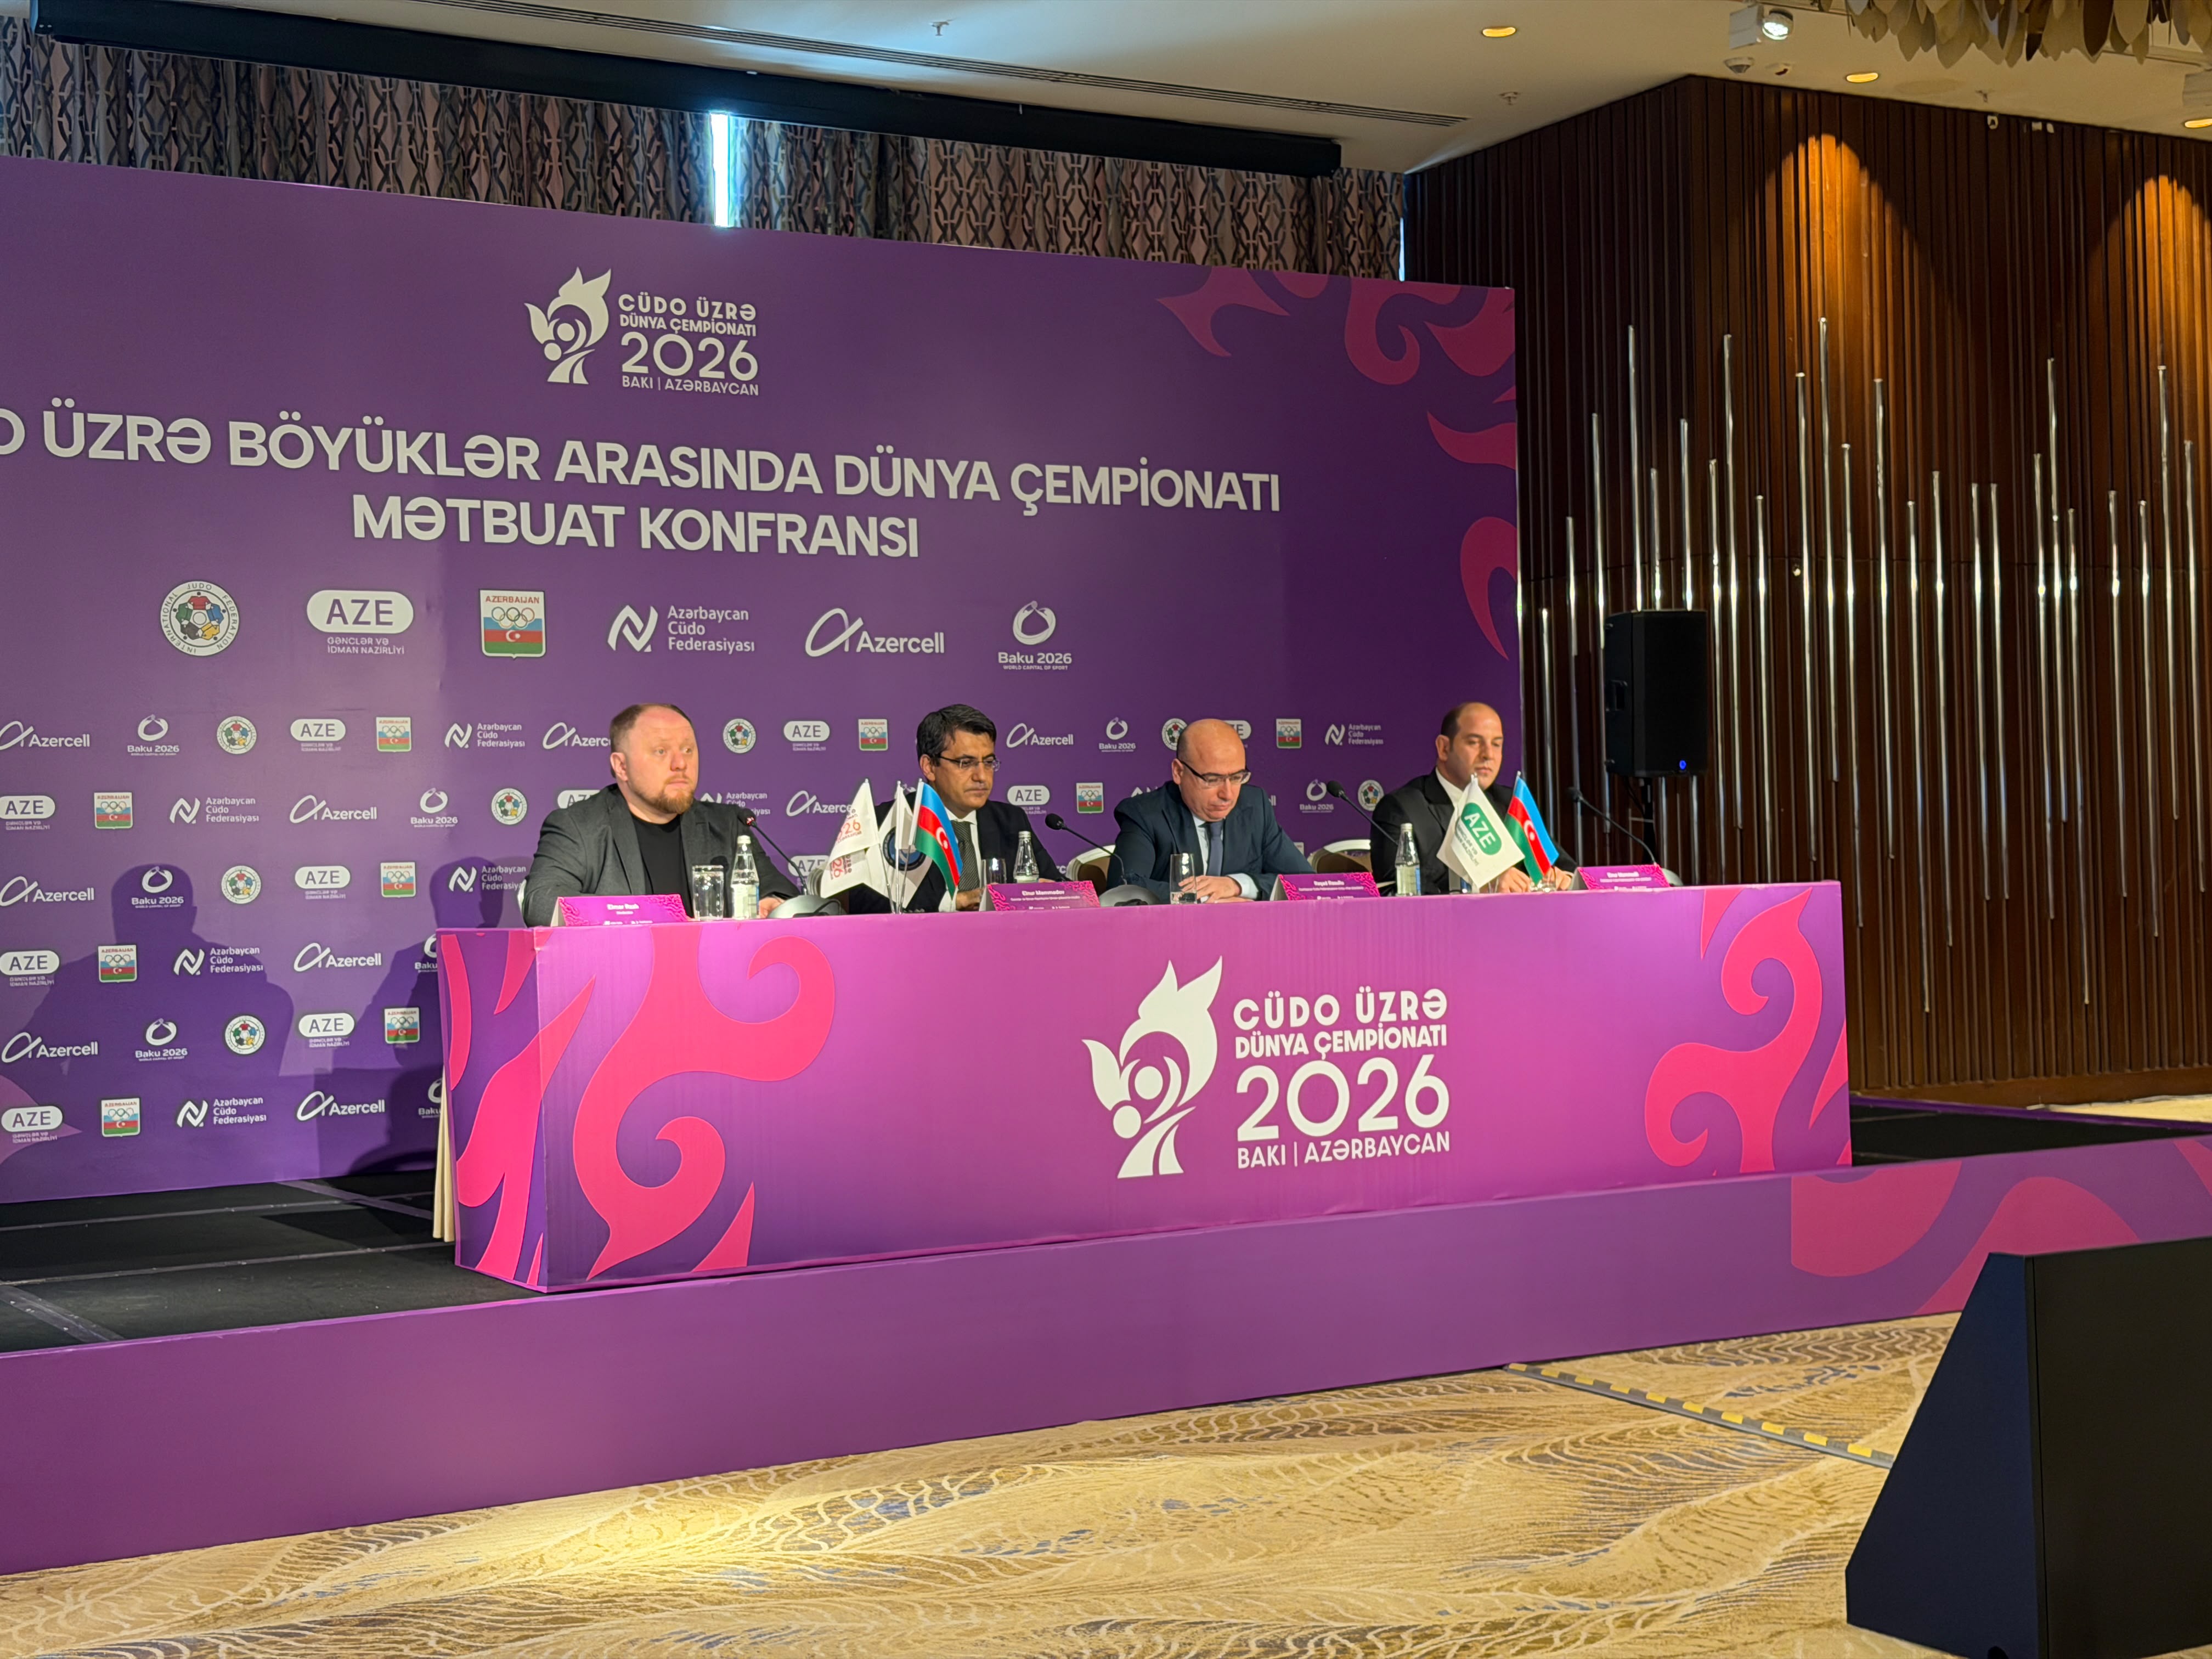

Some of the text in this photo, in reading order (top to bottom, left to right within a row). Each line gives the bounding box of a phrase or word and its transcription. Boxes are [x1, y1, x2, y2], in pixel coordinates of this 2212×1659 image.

[618, 291, 756, 321] CÜDO ÜZRƏ
[620, 313, 757, 336] DÜNYA ÇEMPİONATI
[621, 331, 758, 381] 2026
[622, 376, 759, 396] BAKI AZƏRBAYCAN
[43, 397, 211, 464] ÜZRƏ
[229, 411, 541, 481] BÖYÜKLƏR
[554, 441, 822, 494] ARASINDA
[836, 445, 1000, 501] DÜNYA
[1011, 457, 1280, 516] ÇEMPİONATI
[353, 494, 918, 557] MƏTBUAT KONFRANSI
[486, 595, 539, 604] AZERBAIJAN
[326, 599, 393, 625] AZE
[668, 606, 749, 621] Azərbaycan
[162, 592, 196, 654] INTERNATIONAL
[216, 595, 238, 651] FEDERATION
[668, 622, 706, 635] Cüdo
[668, 637, 754, 654] Federasiyası
[856, 631, 945, 653] Azercell
[998, 652, 1072, 664] Baku 2026
[301, 724, 335, 737] AZE
[477, 723, 522, 732] Azərbaycan
[792, 725, 821, 737] AZE
[30, 733, 90, 748] Azercell
[477, 739, 525, 748] Federasiyası
[572, 734, 611, 746] Azerc
[1031, 734, 1073, 746] Azercell
[127, 745, 179, 753] Baku 2026
[206, 797, 256, 806] Azərbaycan
[726, 792, 768, 801] Azərbaycan
[1015, 789, 1042, 802] AZE
[5, 800, 43, 815] AZE
[812, 802, 853, 813] Azerce
[206, 814, 259, 823] Federasiyası
[321, 808, 377, 821] Azercell
[1464, 812, 1496, 848] AZE
[482, 865, 526, 874] Azərbaycan
[305, 871, 340, 884] AZE
[482, 882, 521, 891] Federasiy
[33, 888, 94, 902] Azercell
[132, 897, 157, 905] Baku
[210, 947, 260, 958] Azərbaycan
[9, 956, 47, 972] AZE
[210, 956, 233, 964] Cüdo
[326, 953, 381, 968] Azercell
[210, 964, 263, 975] Federasiyası
[1233, 986, 1447, 1030] CÜDO ÜZRƏ
[309, 1018, 343, 1033] AZE
[1235, 1022, 1447, 1060] DÜNYA ÇEMPİONATI
[37, 1042, 98, 1058] Azercell
[136, 1048, 187, 1058] Baku 2026
[213, 1097, 263, 1108] Azərbaycan
[1237, 1054, 1449, 1142] 2026
[213, 1107, 236, 1115] Cüdo
[329, 1100, 385, 1115] Azercell
[12, 1110, 50, 1127] AZE
[213, 1114, 267, 1125] Federasiyası
[1238, 1131, 1450, 1169] BAKI AZƏRBAYCAN
